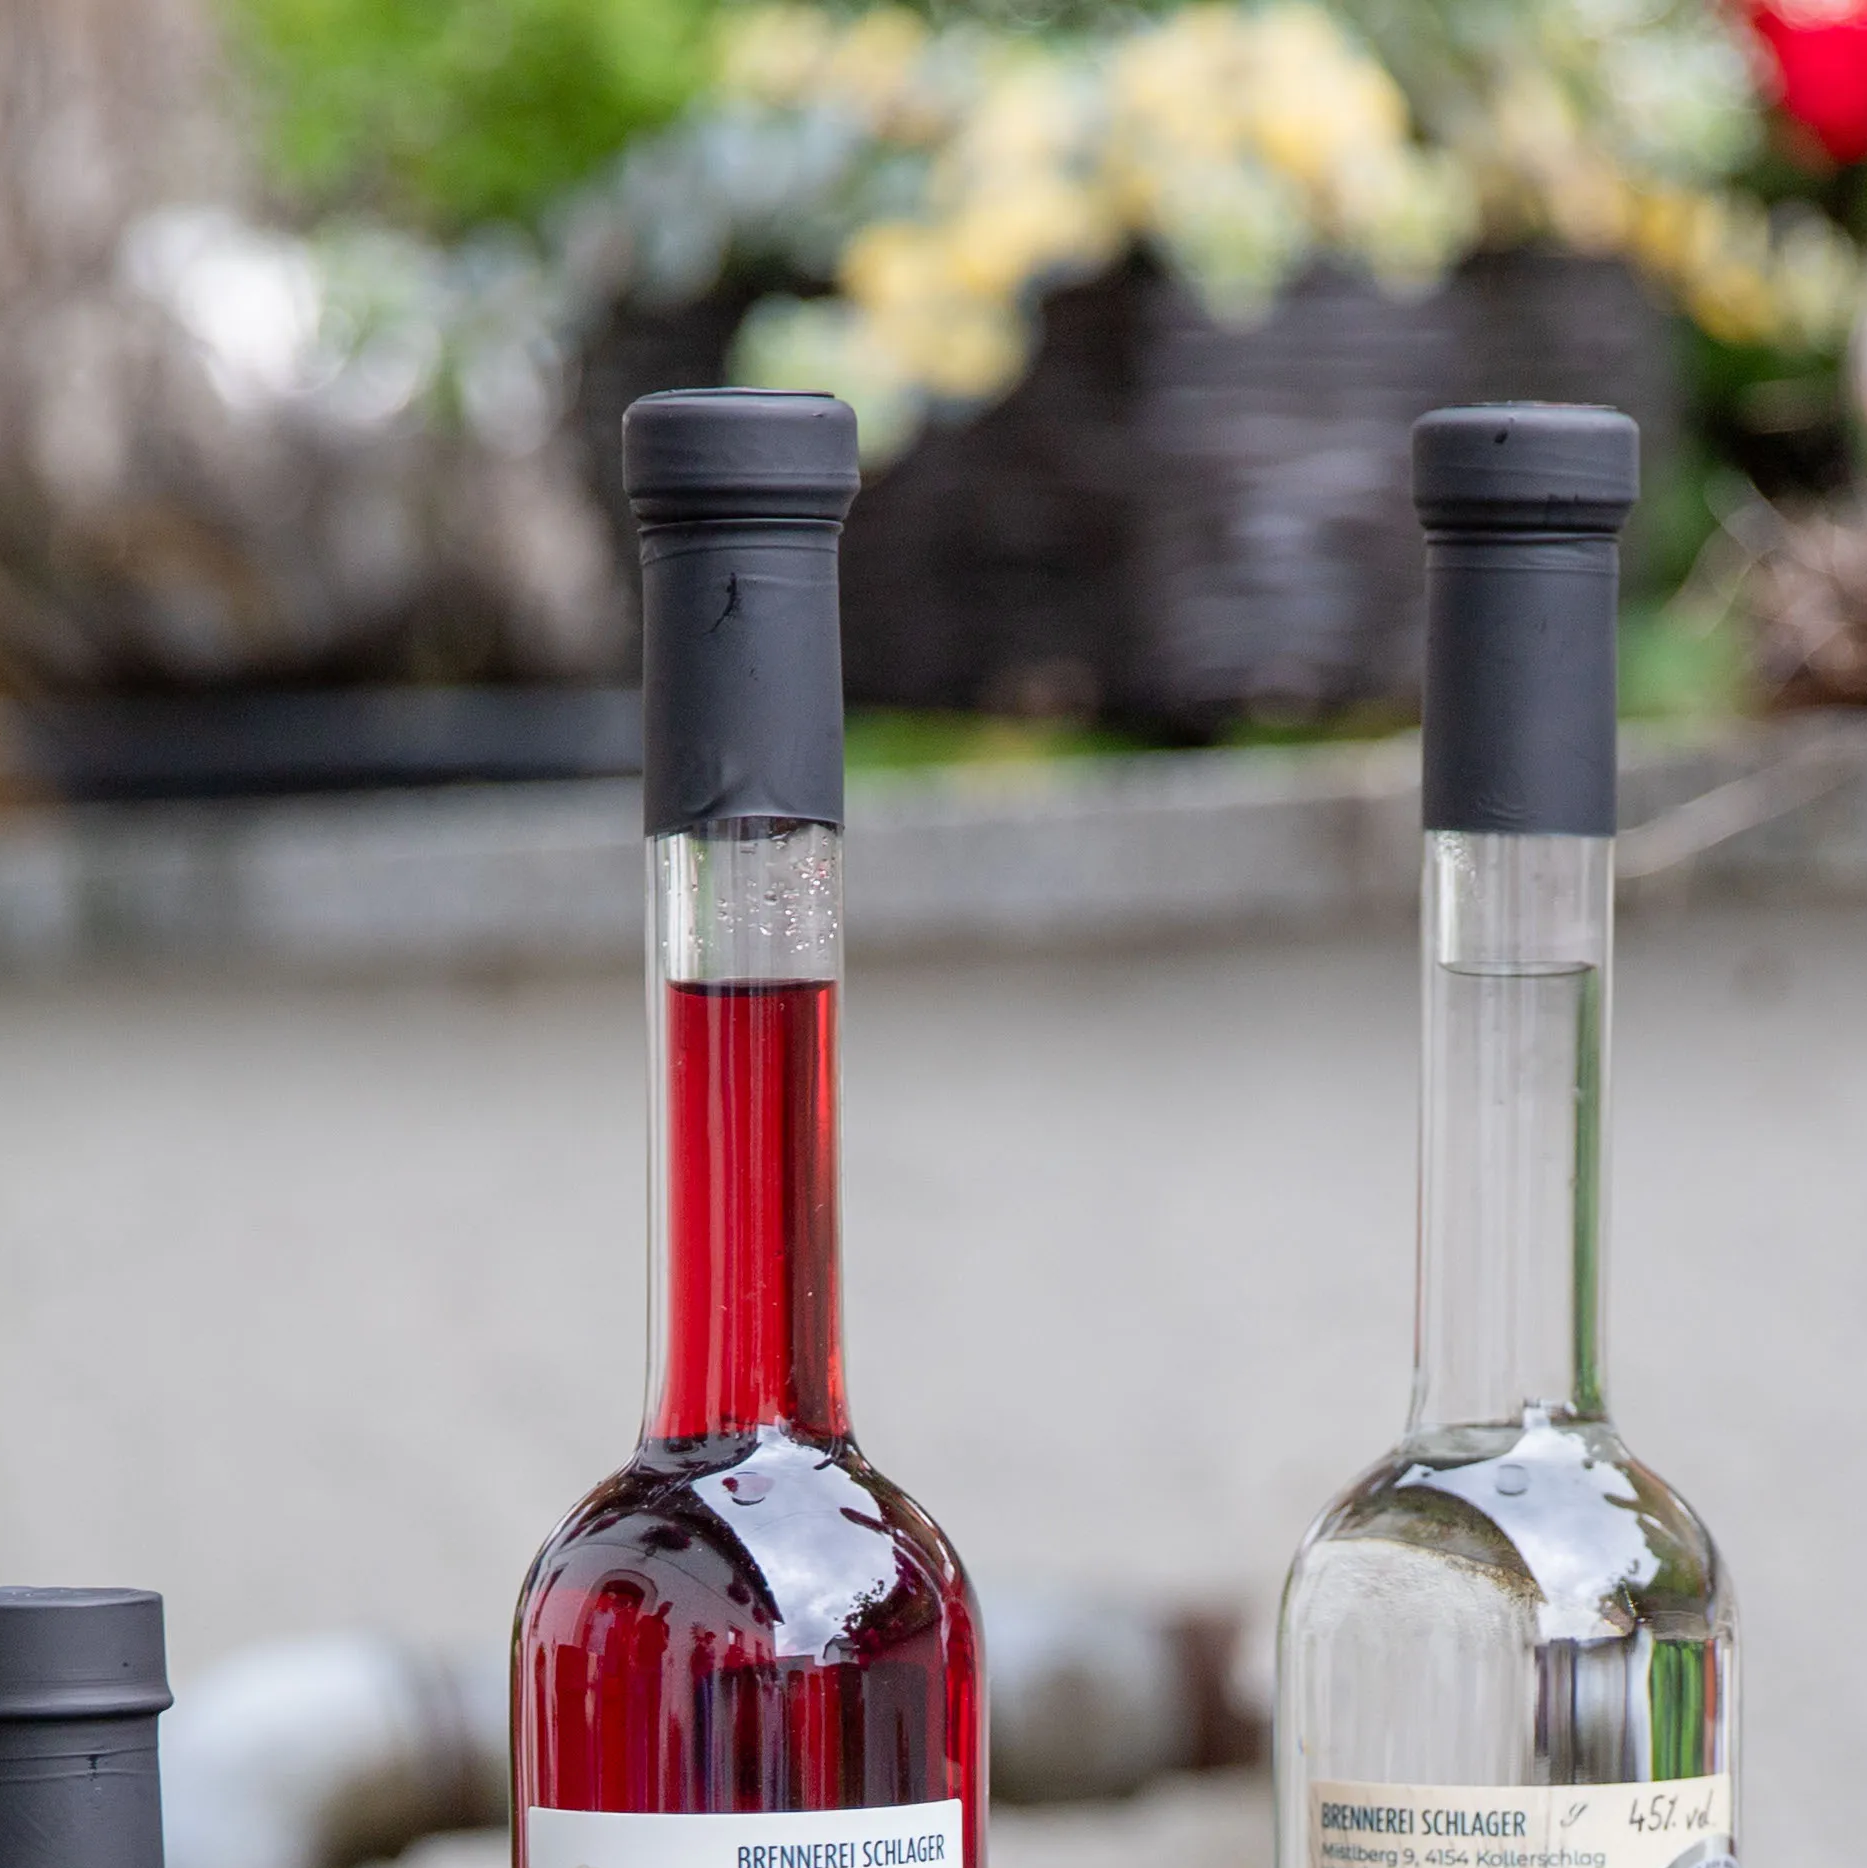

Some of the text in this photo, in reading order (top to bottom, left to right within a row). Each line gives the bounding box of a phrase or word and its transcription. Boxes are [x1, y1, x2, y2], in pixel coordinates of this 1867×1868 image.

[1322, 1802, 1526, 1838] BRENNEREI SCHLAGER
[863, 1834, 945, 1868] SCHLAGER
[1403, 1851, 1420, 1868] 9,
[1425, 1850, 1469, 1867] 4154
